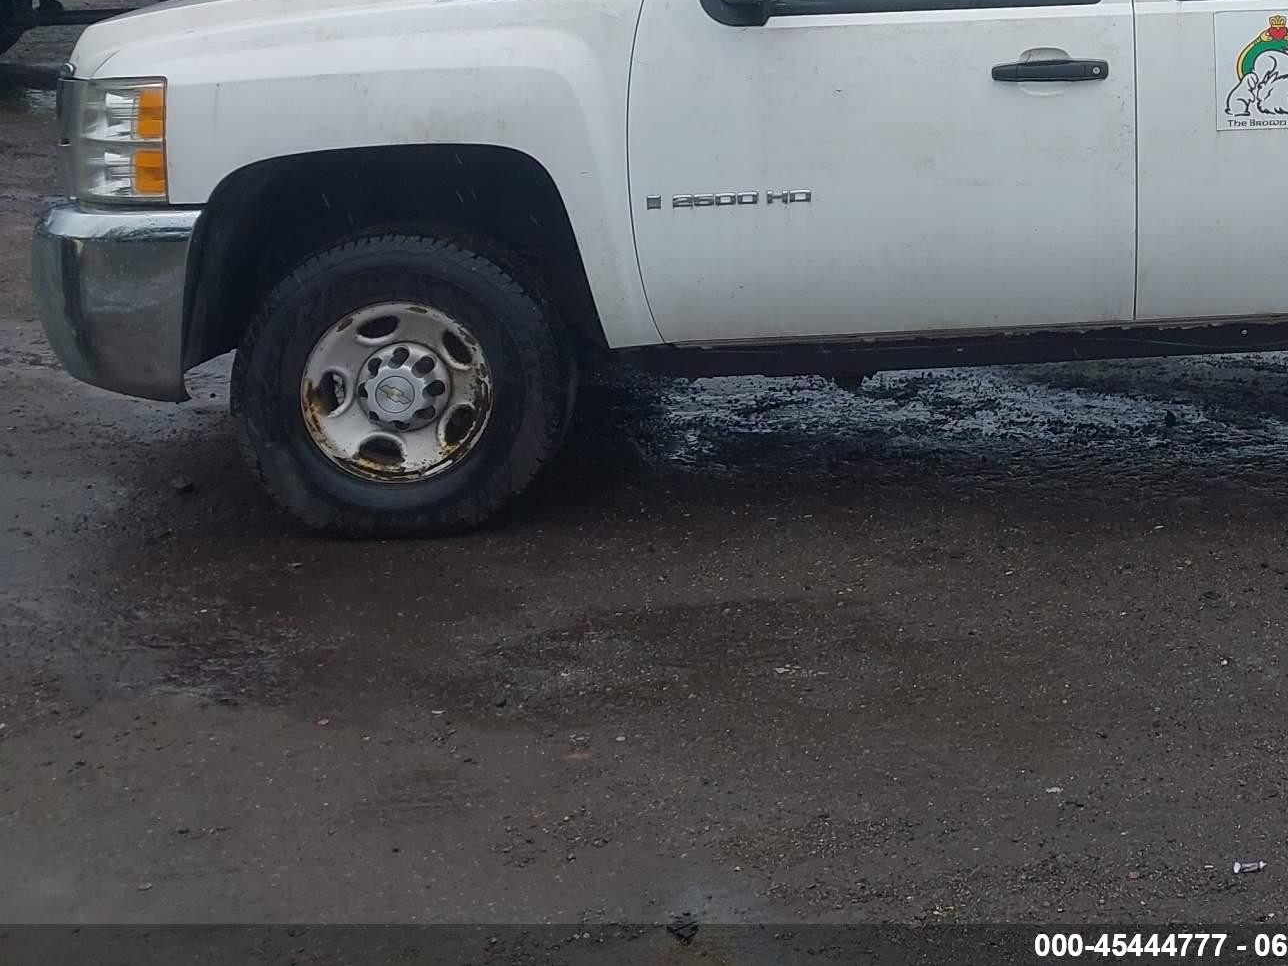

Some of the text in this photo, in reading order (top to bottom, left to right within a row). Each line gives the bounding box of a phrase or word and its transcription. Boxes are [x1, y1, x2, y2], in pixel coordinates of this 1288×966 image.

[1227, 119, 1247, 127] The
[1249, 118, 1287, 127] Brown
[672, 191, 759, 209] 2500
[766, 189, 812, 206] HD
